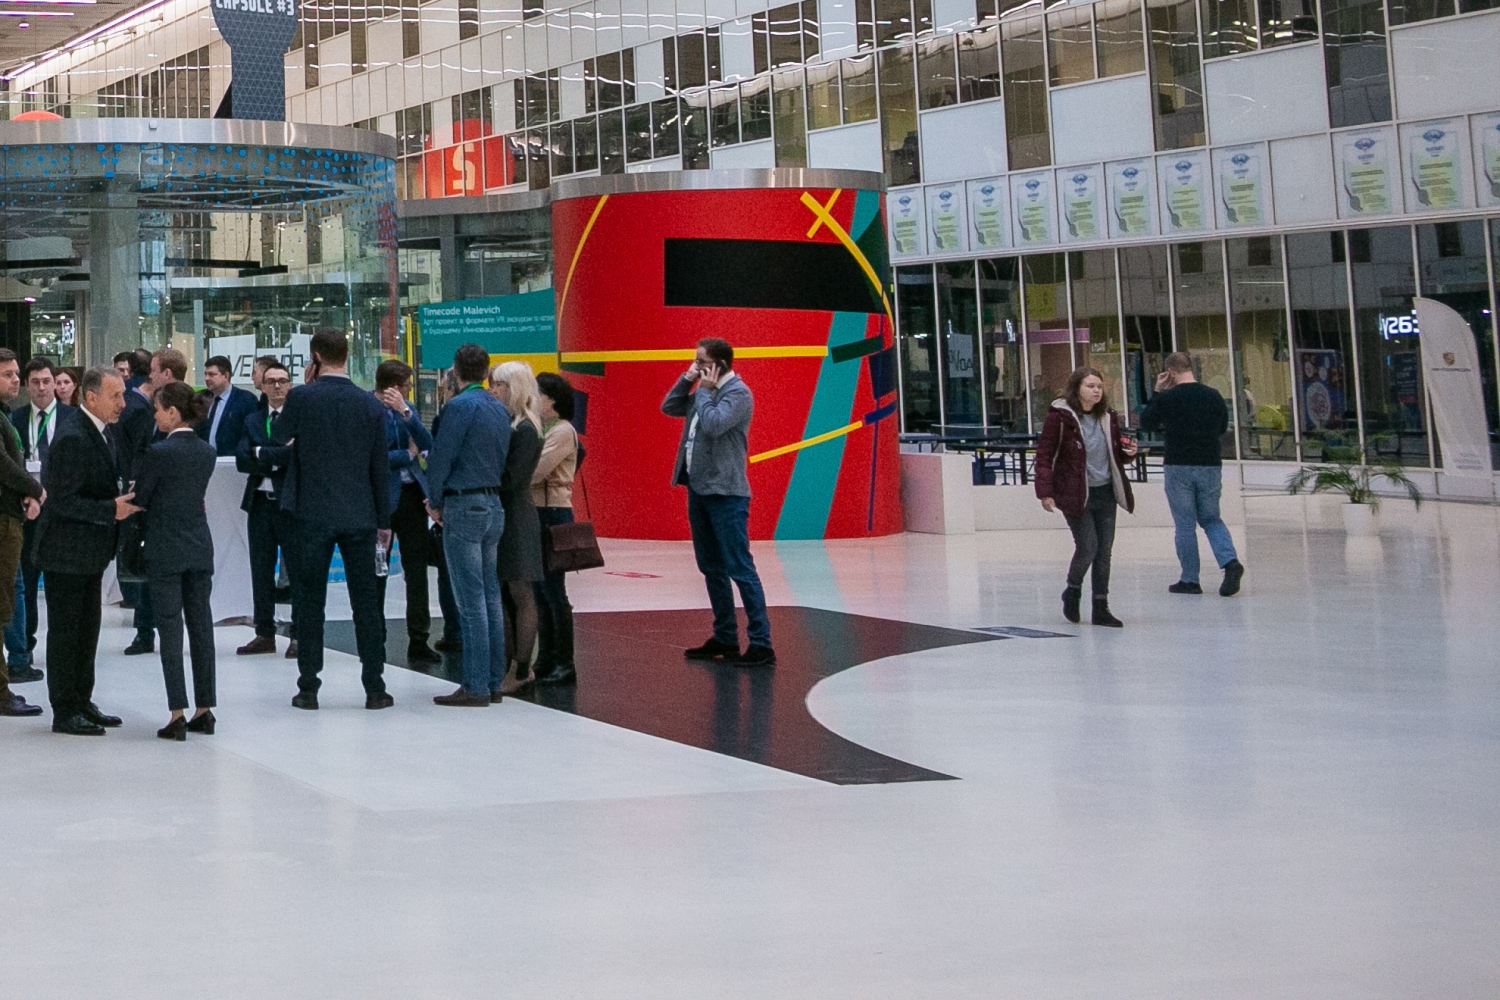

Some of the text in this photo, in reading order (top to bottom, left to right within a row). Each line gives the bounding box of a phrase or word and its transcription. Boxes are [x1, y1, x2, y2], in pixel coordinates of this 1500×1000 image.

[423, 305, 501, 316] Timecode Malevich
[435, 317, 458, 325] проект
[465, 316, 494, 326] формате
[428, 326, 461, 335] будущему
